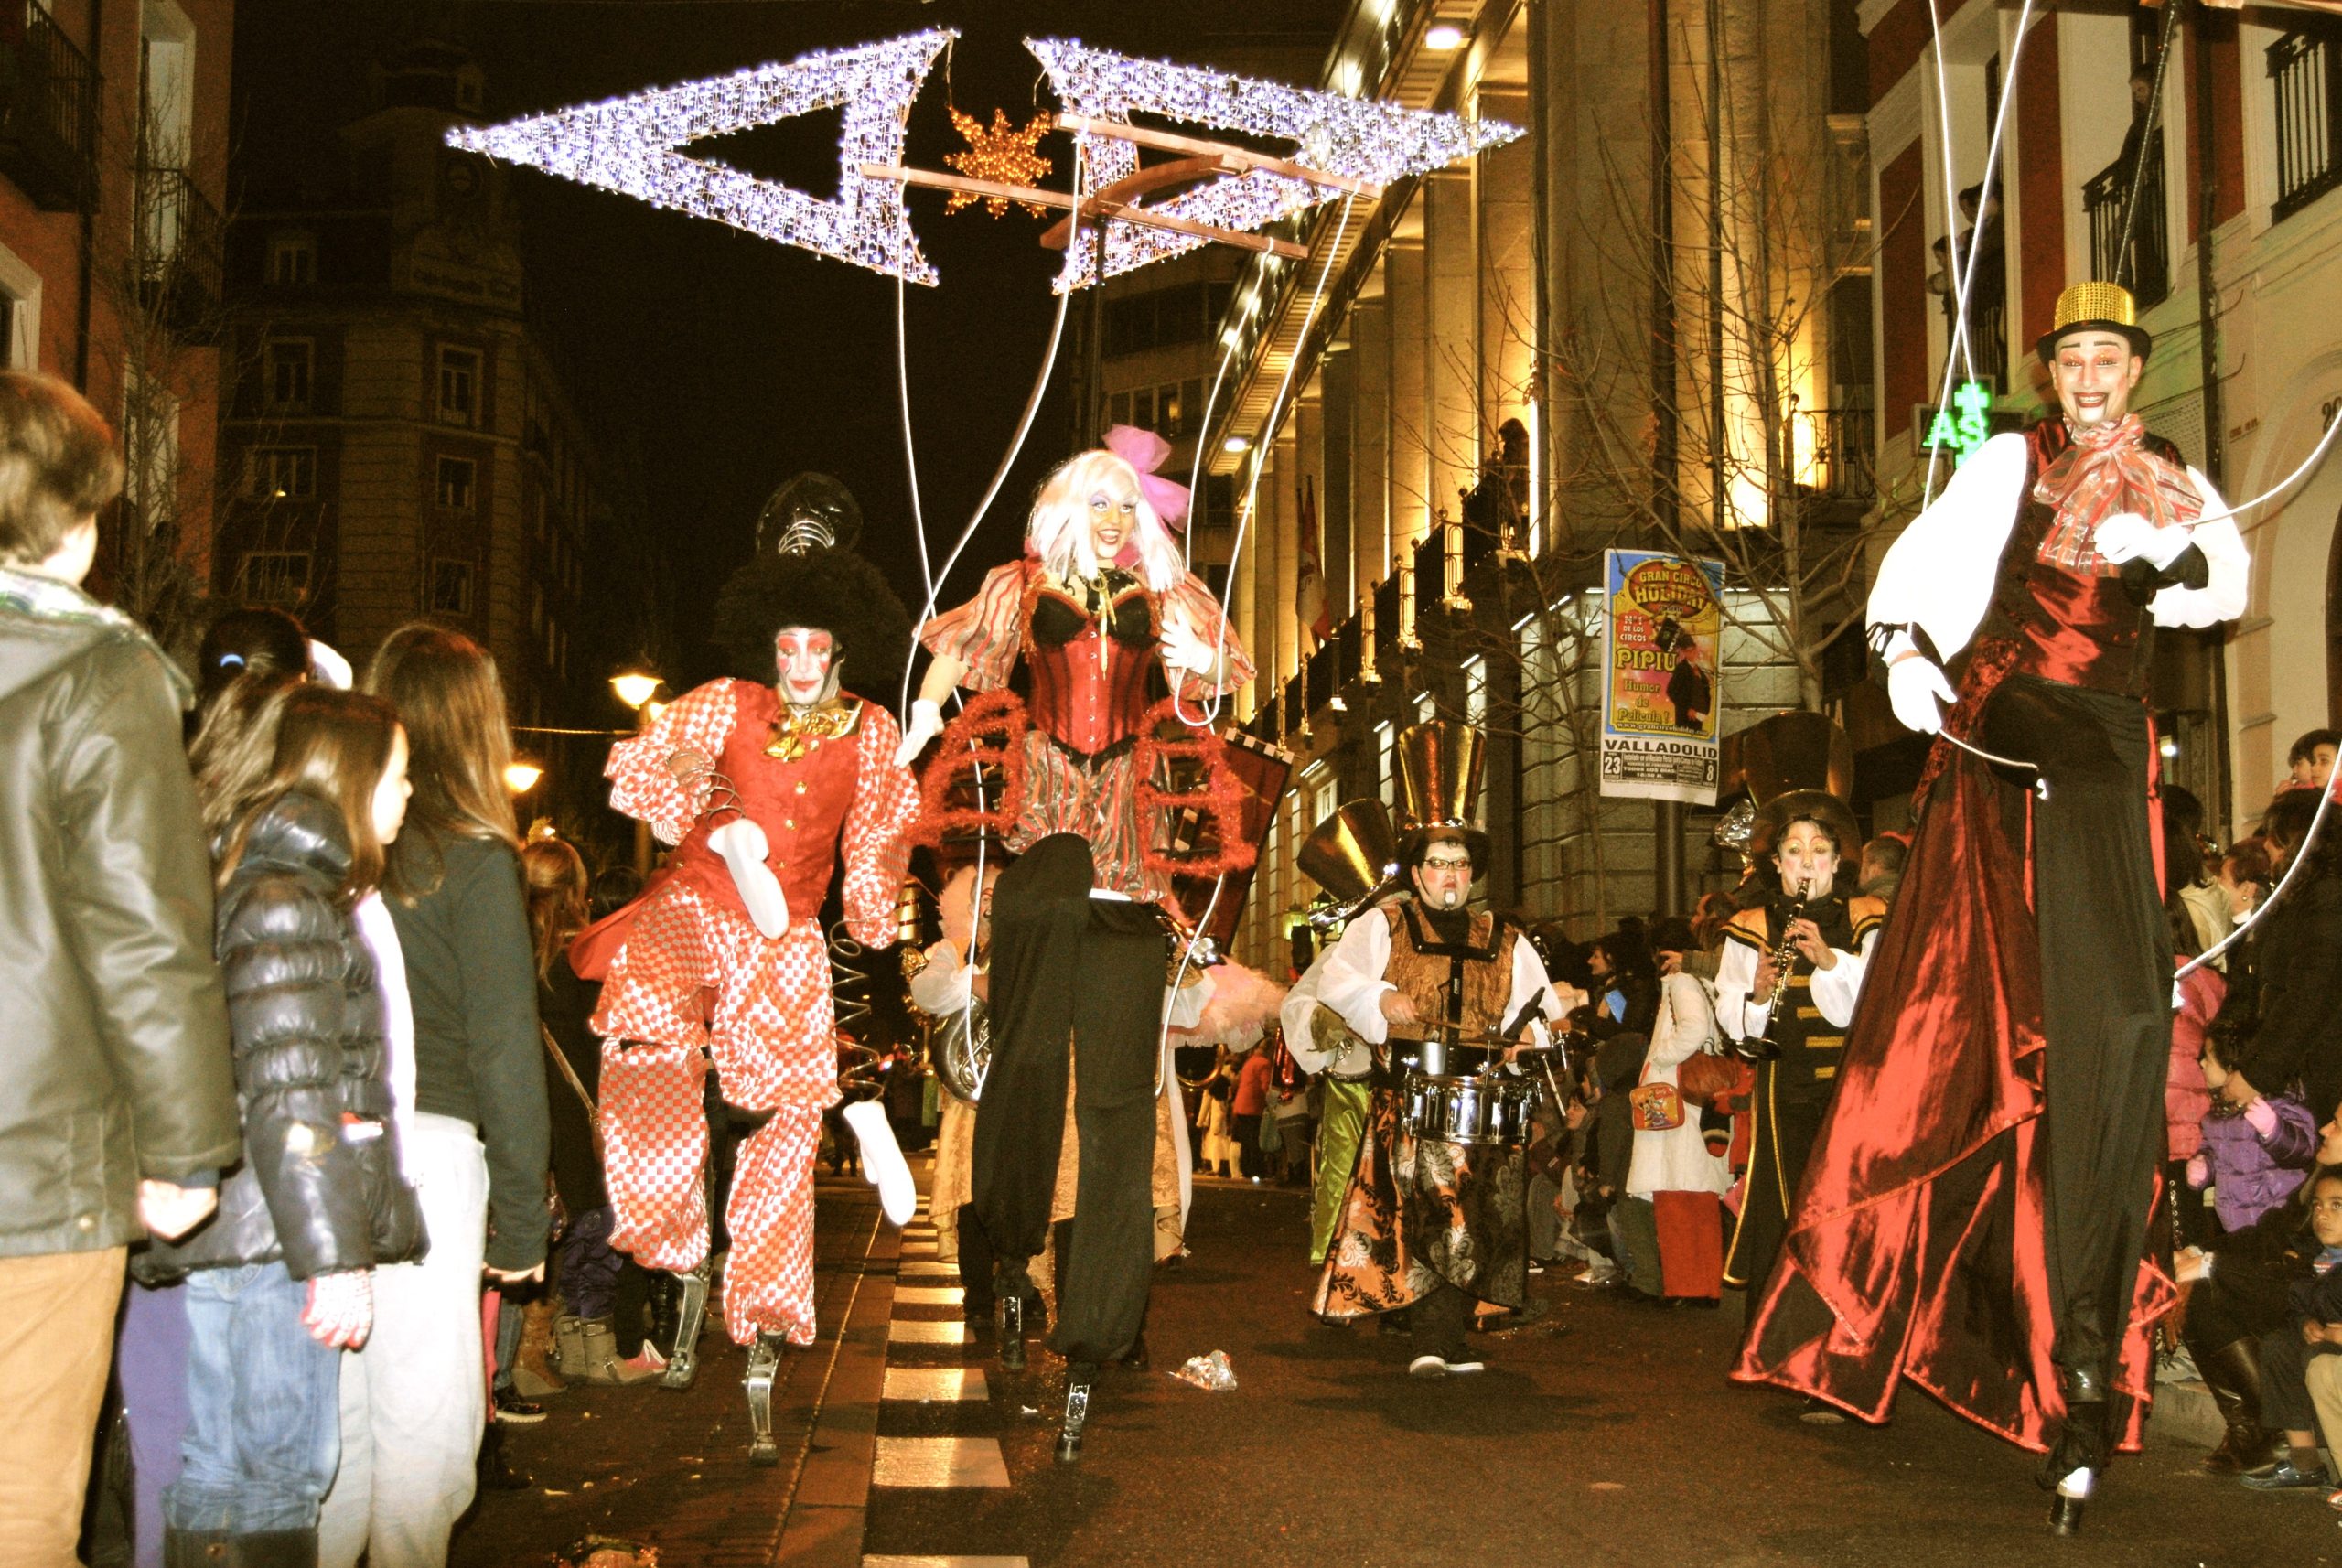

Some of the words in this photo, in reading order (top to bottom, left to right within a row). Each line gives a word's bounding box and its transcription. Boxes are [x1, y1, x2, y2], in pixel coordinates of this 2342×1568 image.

[1639, 571, 1670, 583] GRAN
[1672, 572, 1703, 588] CIRCO
[1635, 584, 1705, 610] HOLIDAY
[1619, 633, 1647, 642] CIRCOS
[1624, 679, 1661, 693] Humor
[1636, 694, 1649, 707] de
[1605, 739, 1718, 759] VALLADOLID
[1605, 756, 1621, 775] 23
[1706, 765, 1714, 781] 8
